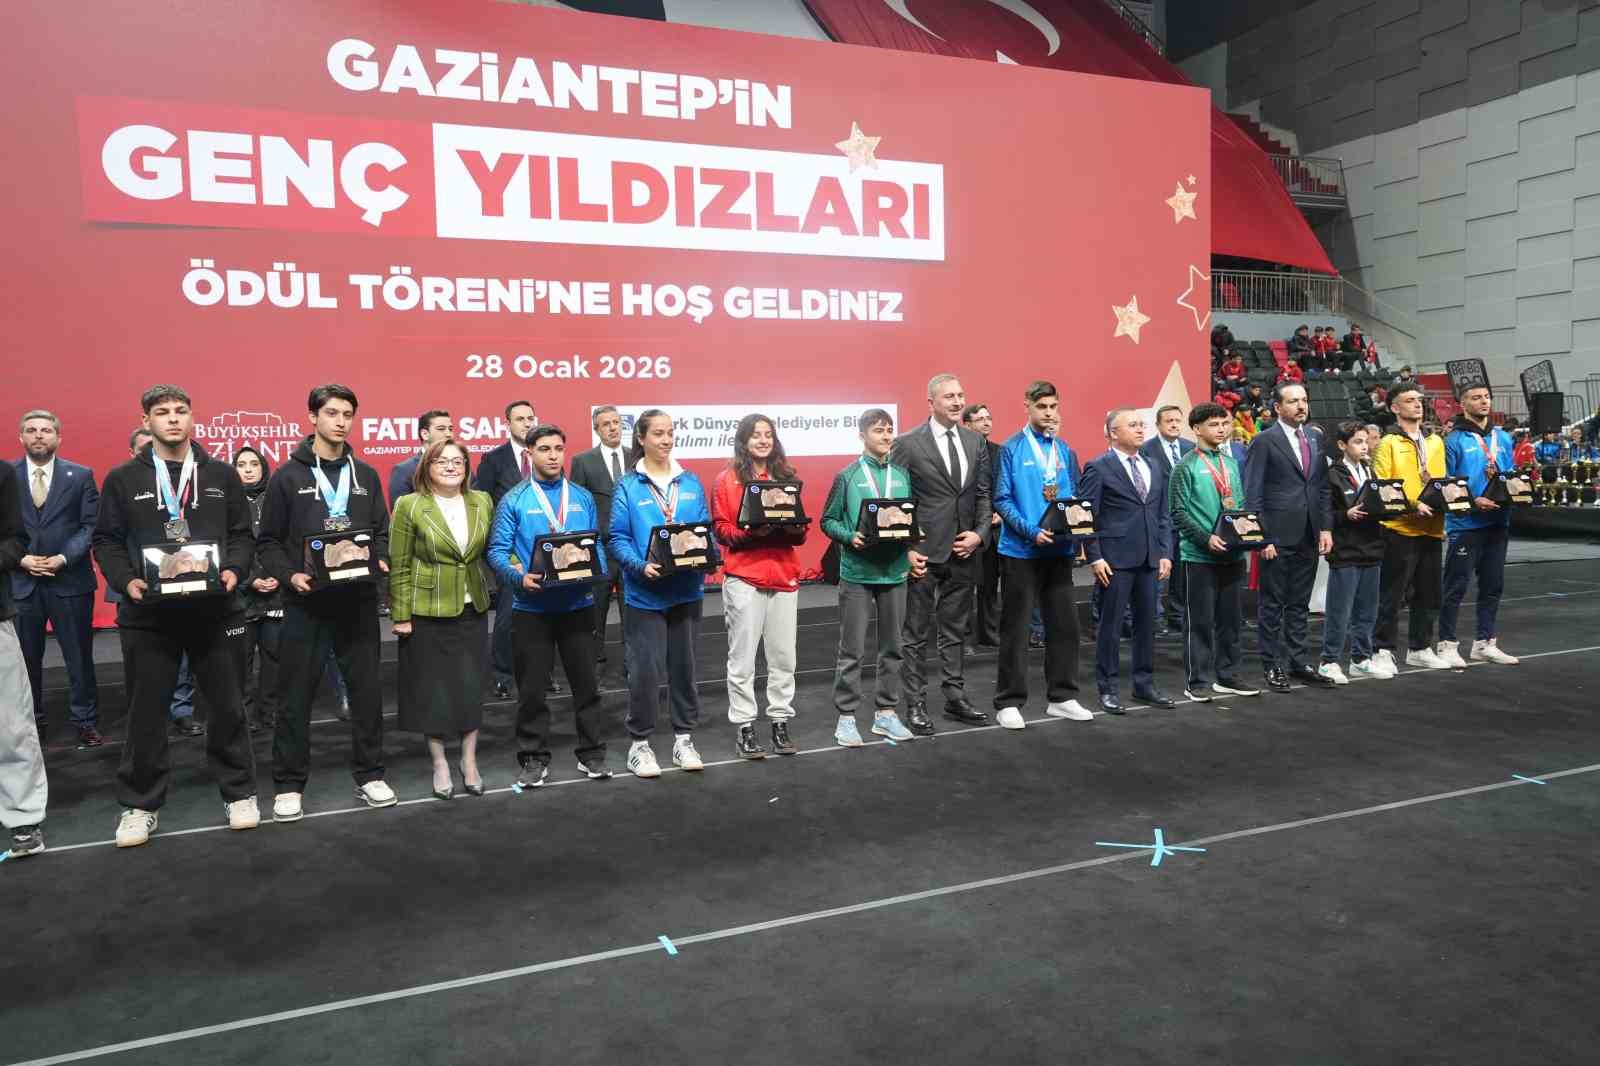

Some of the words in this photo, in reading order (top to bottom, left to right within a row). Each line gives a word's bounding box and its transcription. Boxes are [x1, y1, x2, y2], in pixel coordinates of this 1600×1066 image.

[101, 124, 409, 227] GENÇ
[455, 149, 930, 240] YILDIZLARI
[182, 258, 338, 309] ÖDÜL
[621, 283, 714, 324] HOŞ
[466, 354, 503, 378] 28
[513, 354, 590, 379] Ocak
[599, 355, 672, 379] 2026
[673, 417, 689, 430] rk
[693, 417, 740, 431] Dünya
[775, 416, 839, 431] lediyeler
[674, 434, 713, 447] tılımı
